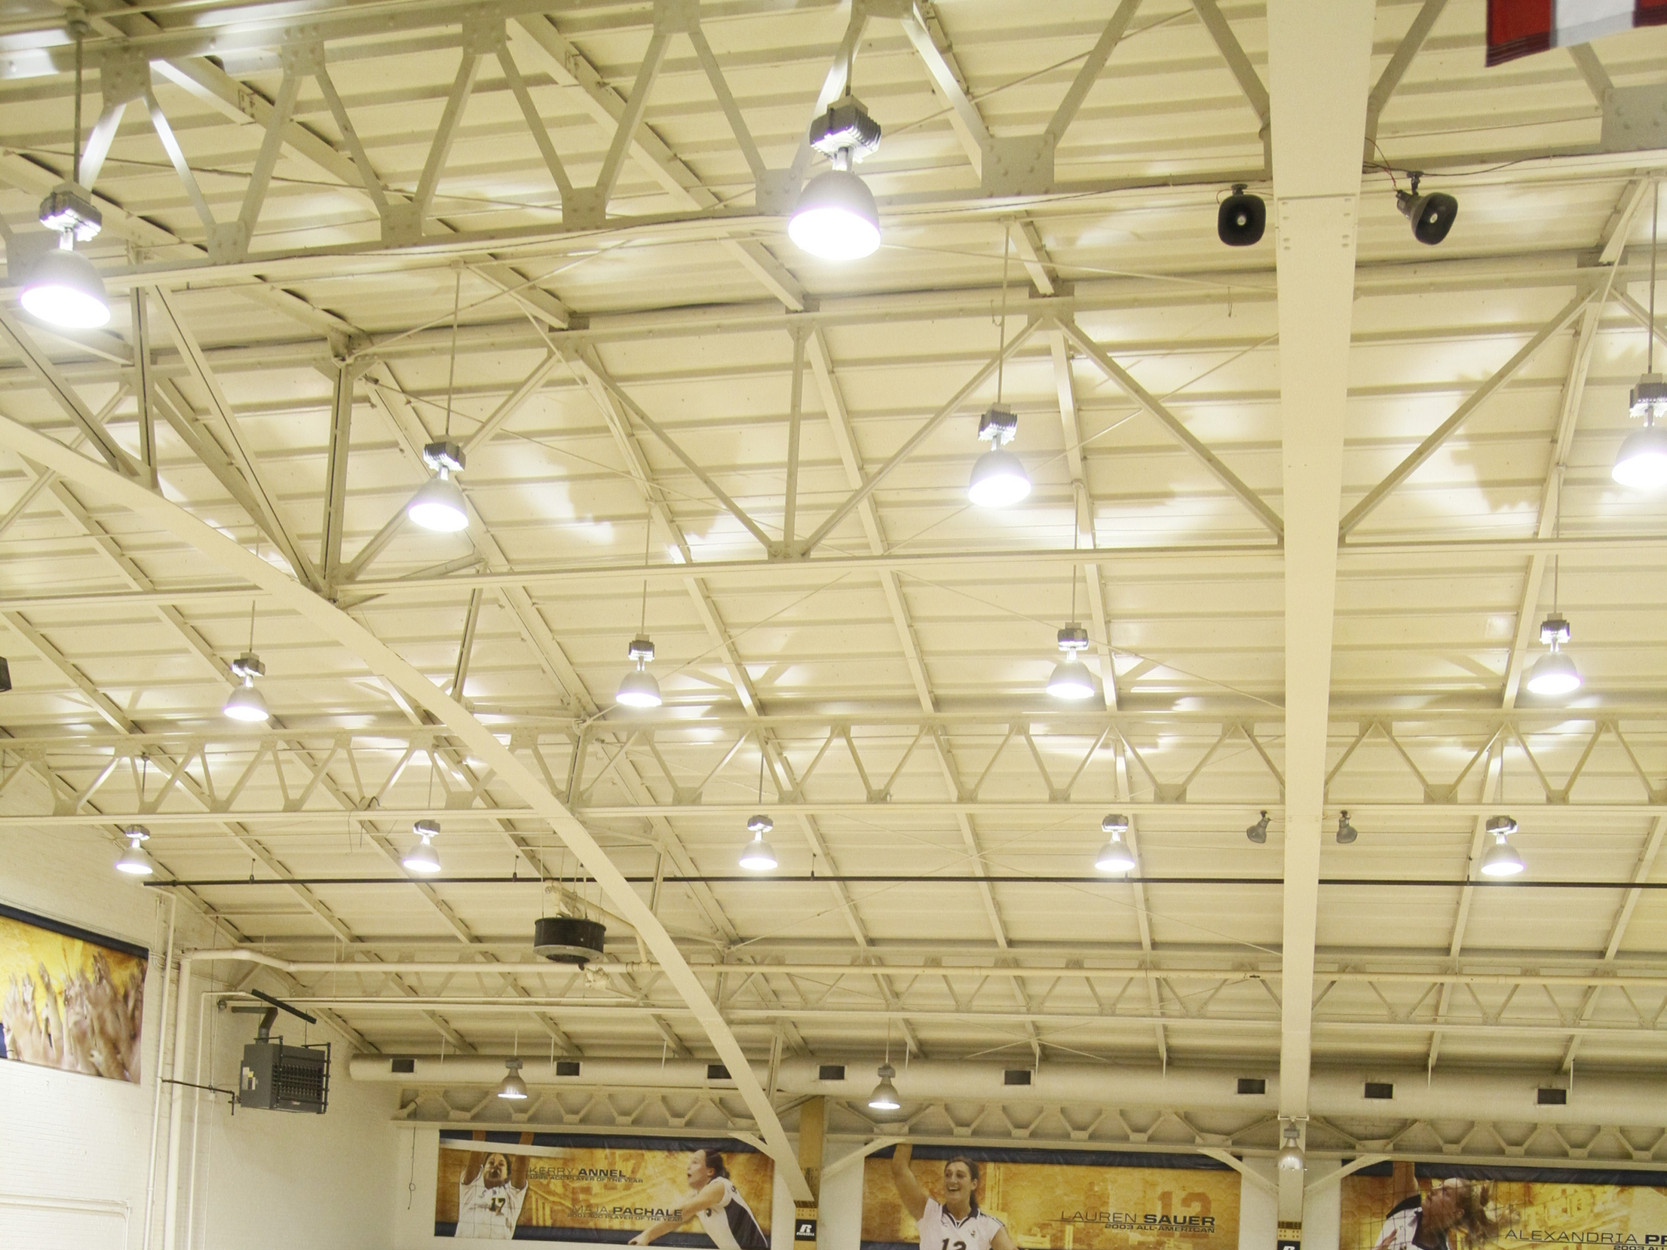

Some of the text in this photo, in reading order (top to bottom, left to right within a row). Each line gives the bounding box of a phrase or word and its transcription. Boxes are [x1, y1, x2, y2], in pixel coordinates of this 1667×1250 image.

[529, 1166, 626, 1177] KERRY ANNEL
[613, 1206, 683, 1217] PACHALE
[1061, 1210, 1215, 1226] LAUREN SAUER
[1136, 1224, 1215, 1233] ALL-AMERICAN
[1504, 1228, 1638, 1244] ALEXANDRIA
